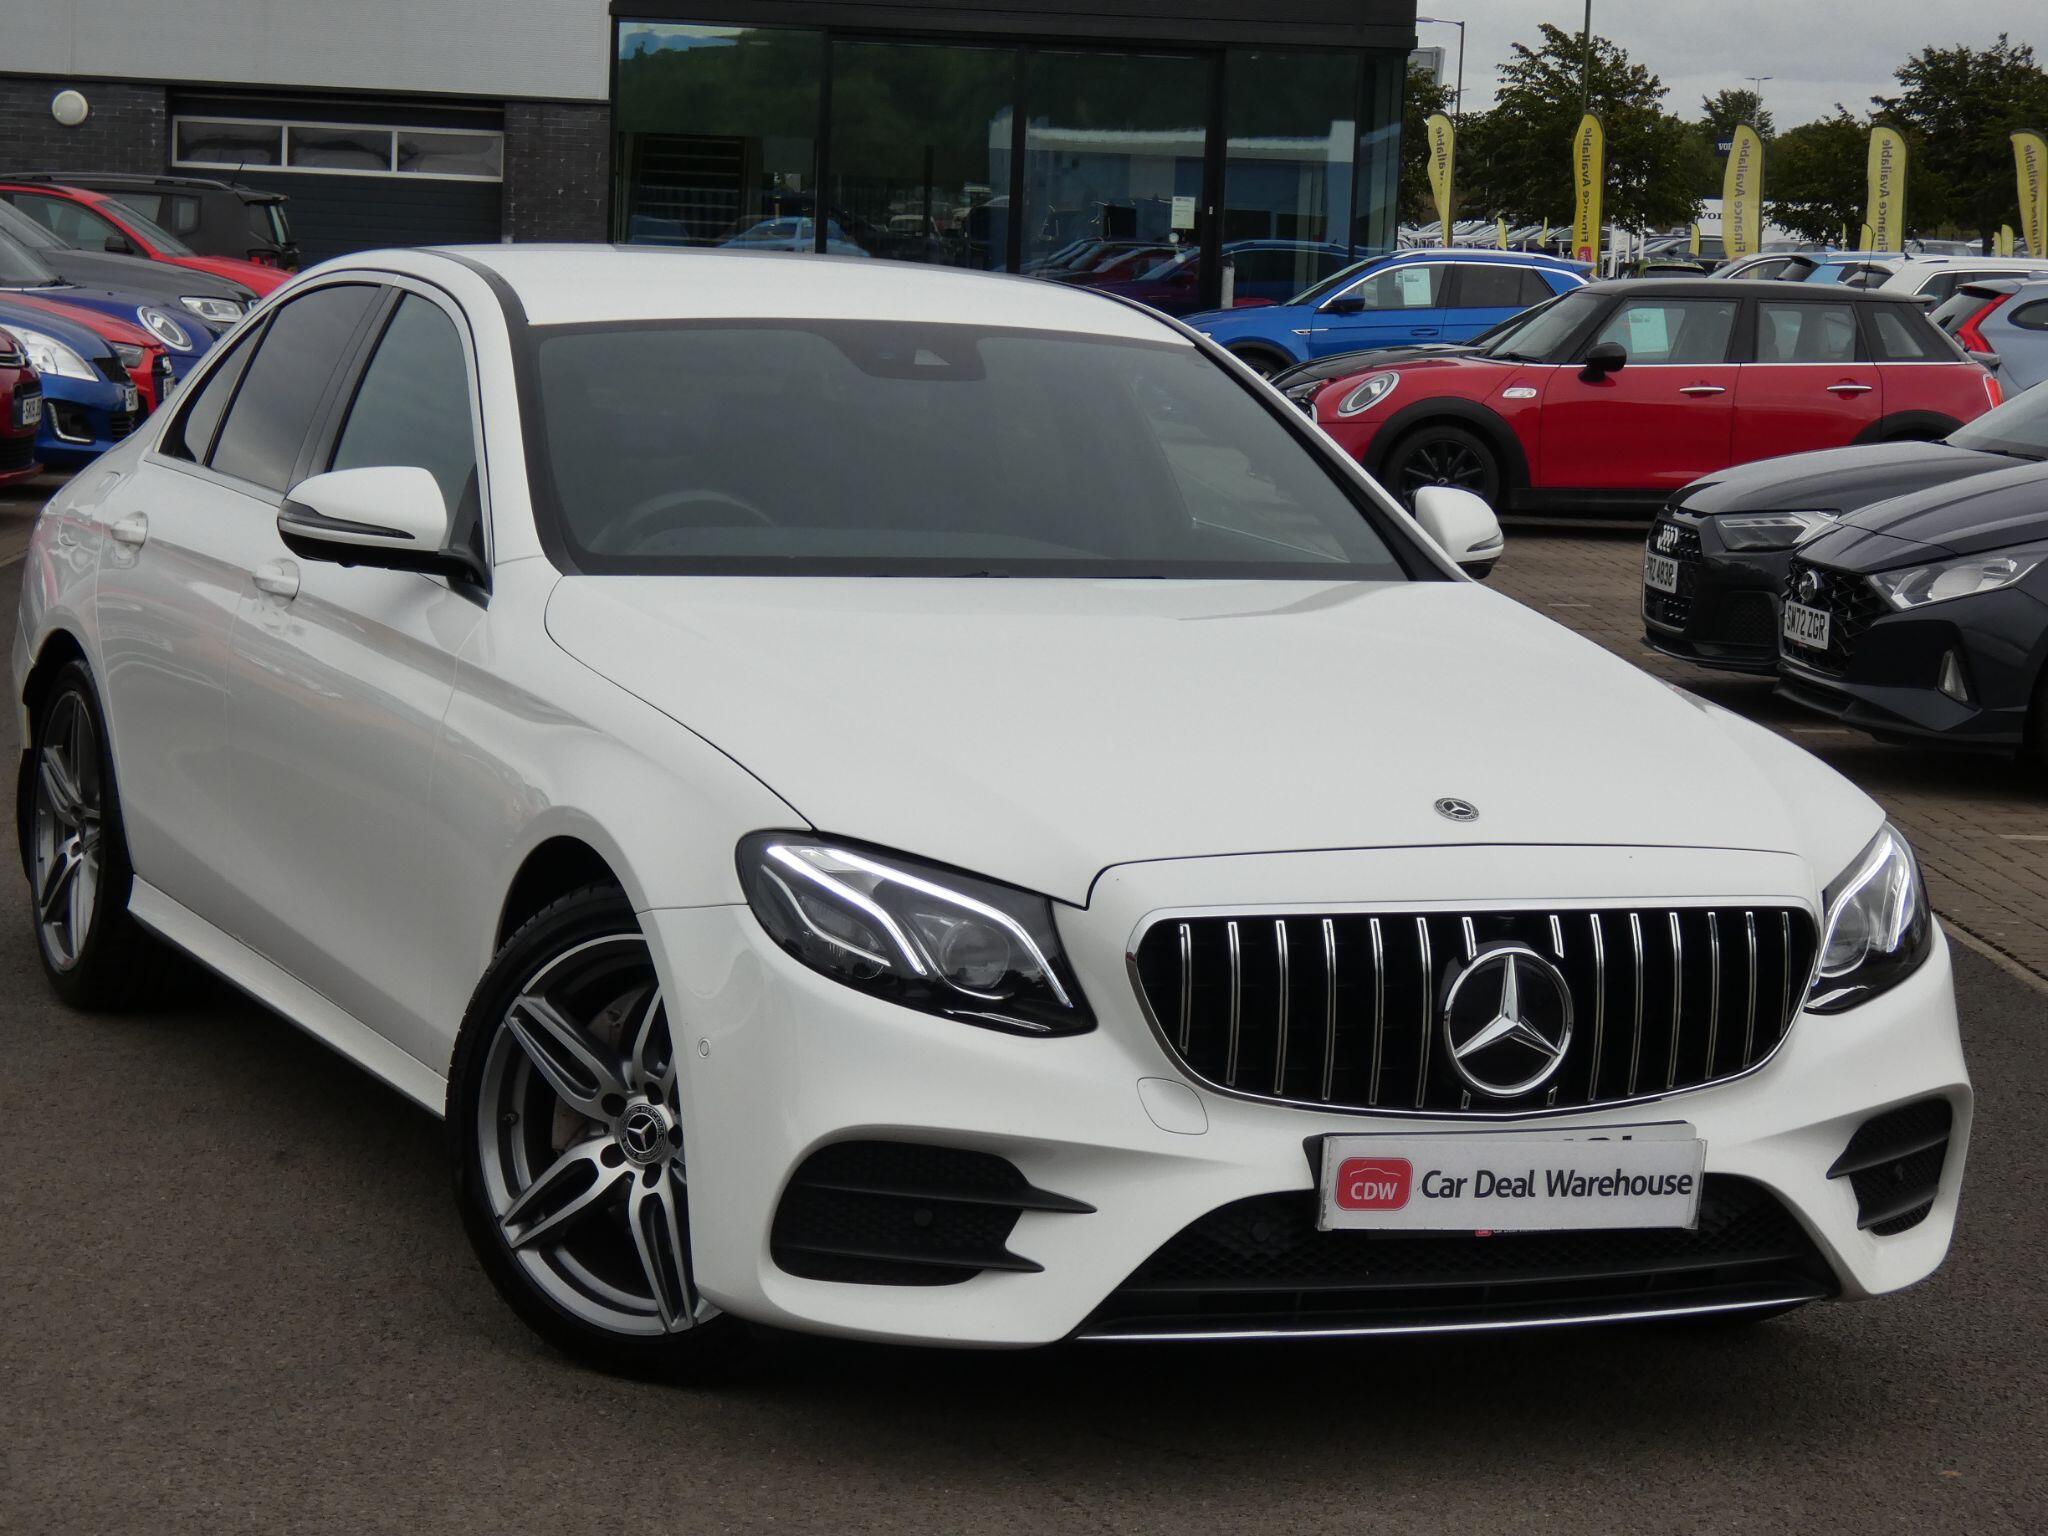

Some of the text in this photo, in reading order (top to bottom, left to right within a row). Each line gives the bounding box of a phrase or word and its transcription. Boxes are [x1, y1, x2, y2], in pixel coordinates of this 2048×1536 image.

[1807, 611, 1826, 642] ZGR
[1350, 1182, 1398, 1200] CDW
[1421, 1168, 1693, 1198] Car Deal Warehouse
